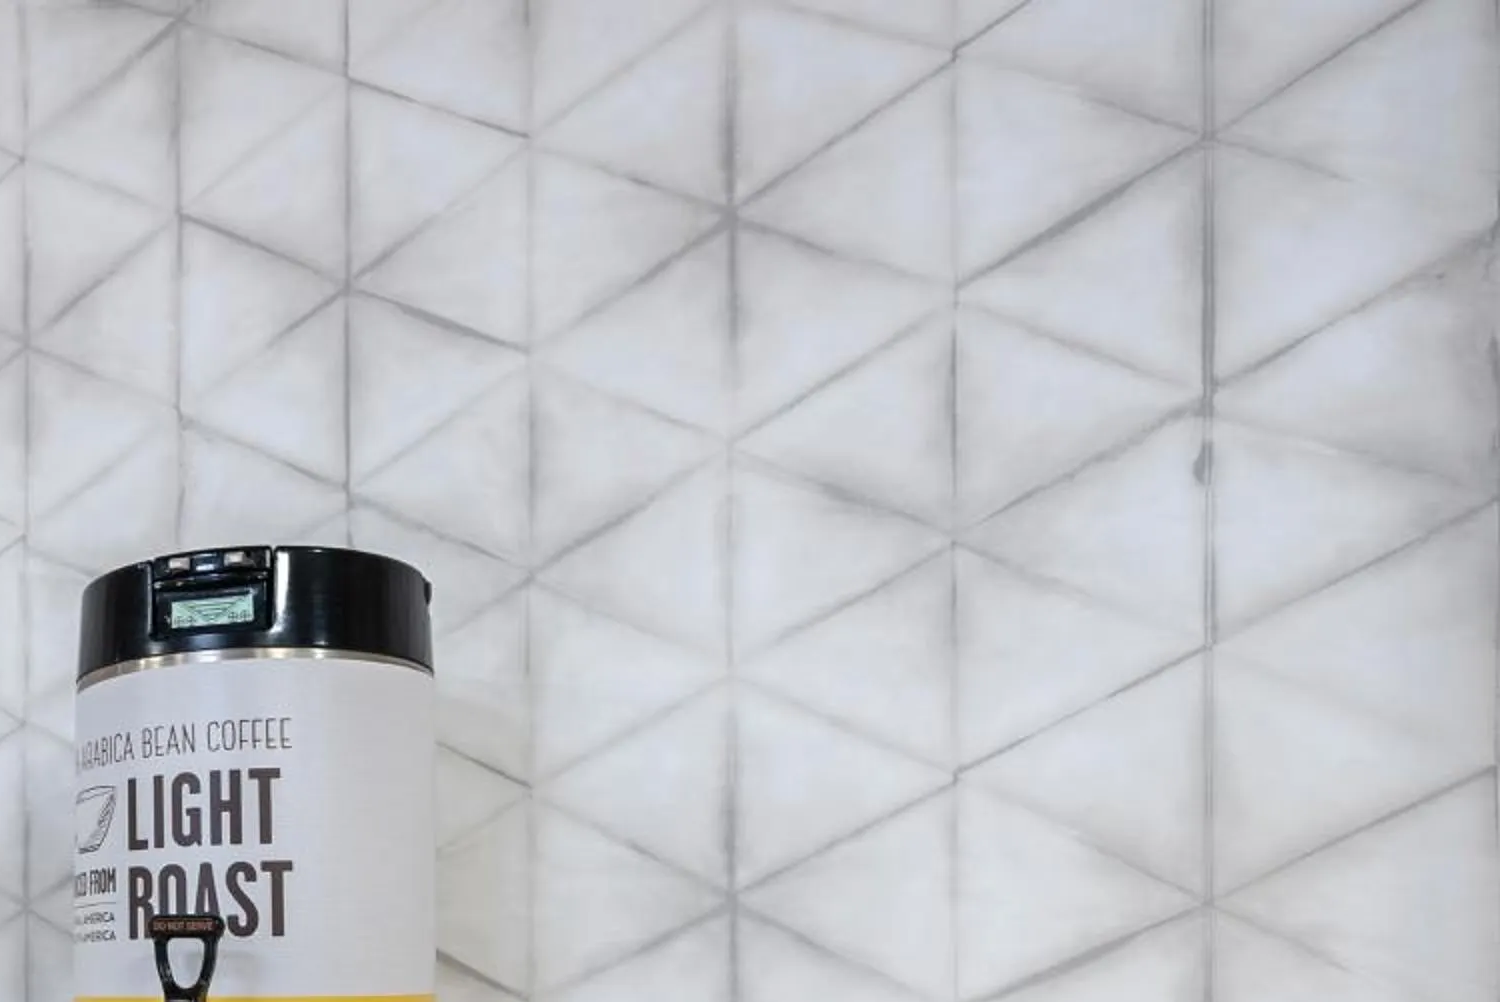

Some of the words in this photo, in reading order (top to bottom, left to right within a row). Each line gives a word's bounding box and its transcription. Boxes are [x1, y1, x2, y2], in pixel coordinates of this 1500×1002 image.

[141, 723, 196, 760] BEAN
[207, 717, 293, 752] COFFEE
[127, 767, 281, 851] LIGHT
[90, 866, 116, 896] FROM
[127, 861, 293, 940] ROAST
